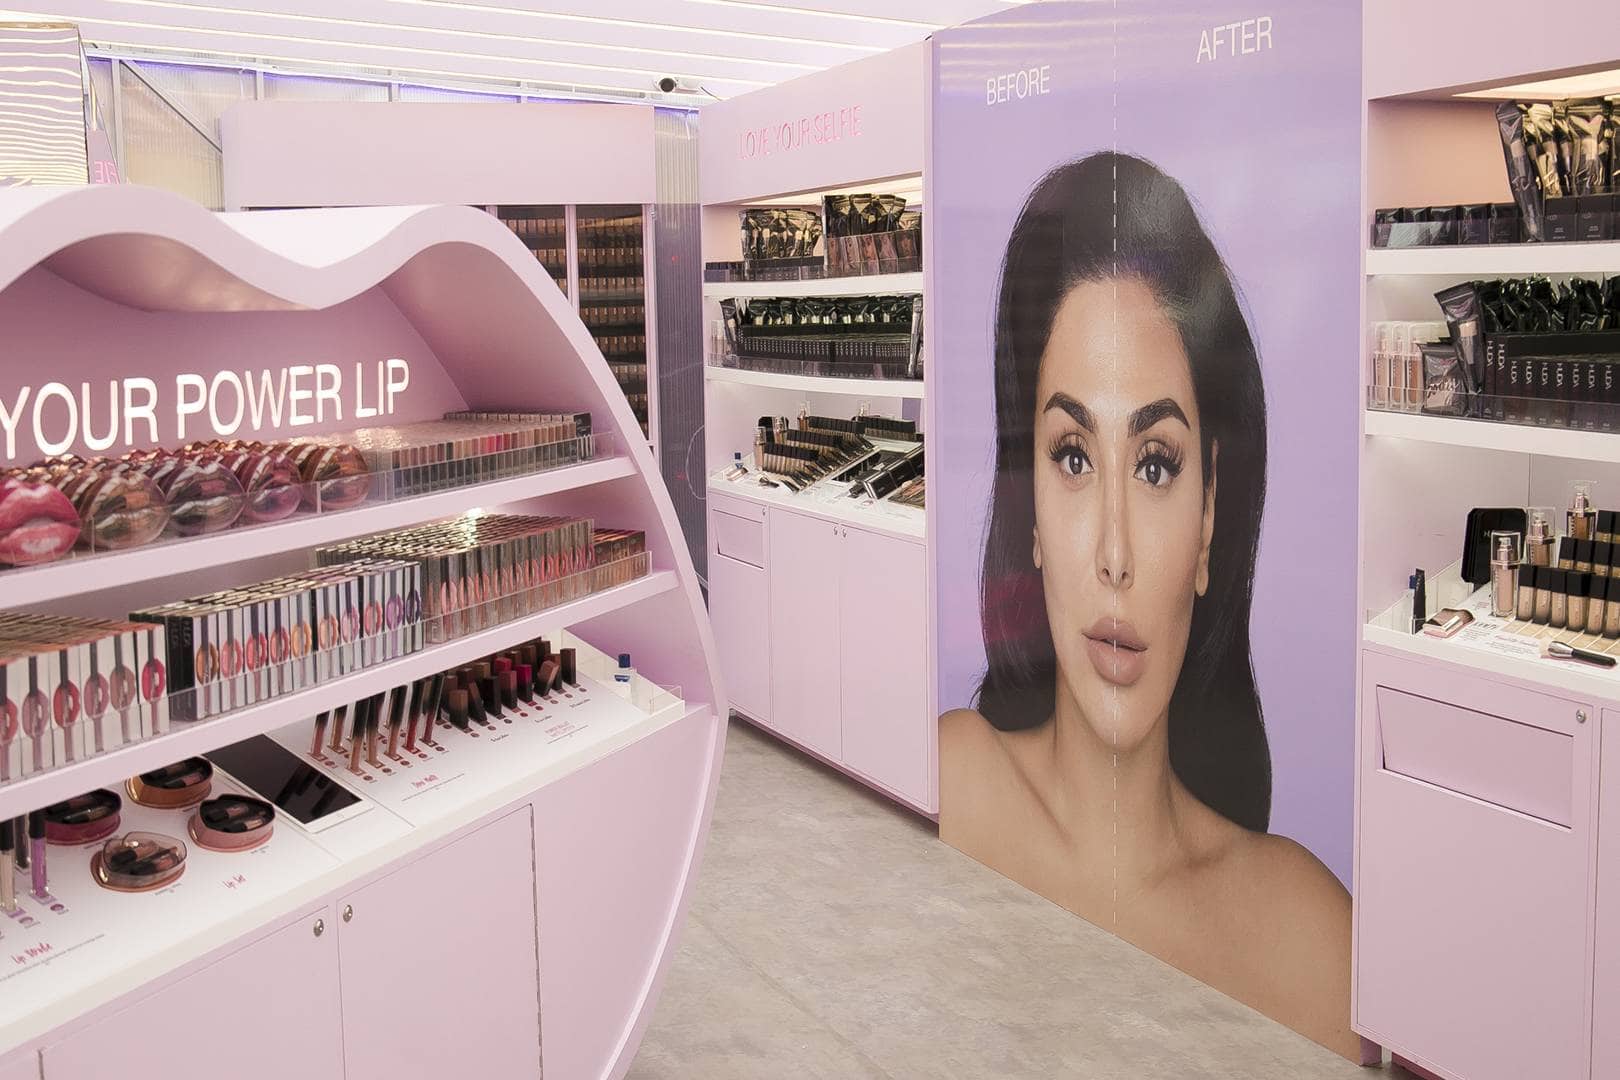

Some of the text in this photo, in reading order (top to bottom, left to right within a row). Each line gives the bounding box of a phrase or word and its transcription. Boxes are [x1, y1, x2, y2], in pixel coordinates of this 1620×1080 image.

[1196, 16, 1273, 63] AFTER
[986, 65, 1051, 106] BEFORE
[738, 104, 863, 160] LOVE YOUR SELFIE
[1486, 340, 1494, 368] HUDA
[1497, 343, 1505, 371] HUDA
[1525, 361, 1533, 385] HUDA
[1556, 362, 1564, 388] HUDA
[1572, 363, 1580, 388] HUDA
[1588, 364, 1596, 389] HUDA
[1604, 365, 1612, 390] HUDA
[0, 358, 410, 460] YOUR POWER LIP
